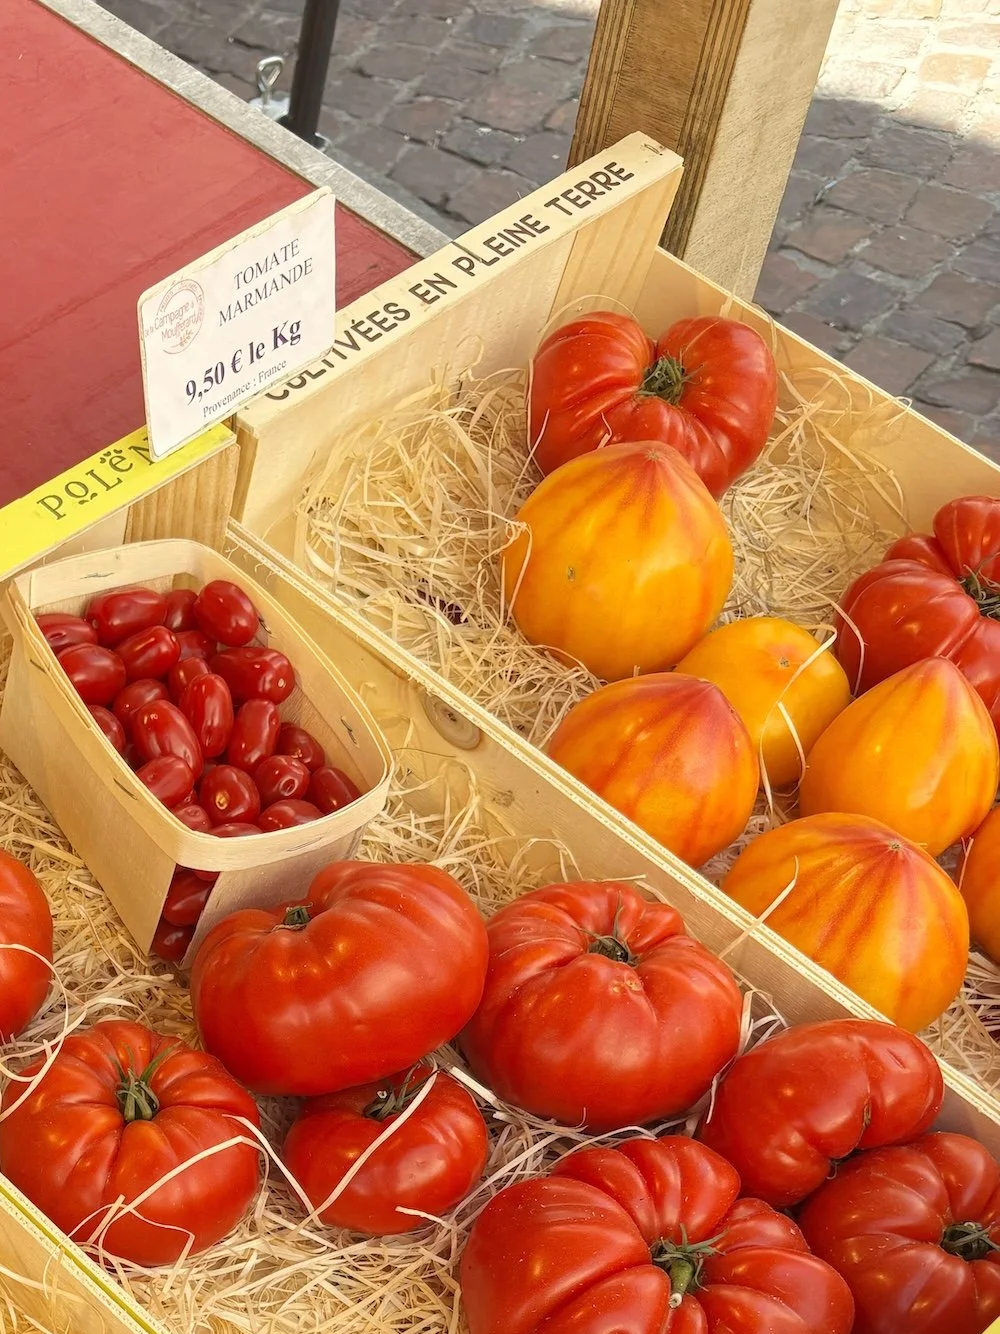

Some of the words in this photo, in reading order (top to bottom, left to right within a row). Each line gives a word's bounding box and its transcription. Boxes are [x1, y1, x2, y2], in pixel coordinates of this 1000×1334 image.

[233, 238, 300, 290] TOMATE
[409, 272, 457, 306] EN
[452, 213, 551, 277] PLEINE
[544, 160, 635, 216] TERRE
[218, 257, 314, 327] MARMANDE
[185, 360, 225, 405] 9,50
[230, 349, 243, 374] €
[249, 340, 266, 364] le
[272, 320, 302, 353] Kg
[203, 381, 251, 418] Provenance
[258, 359, 287, 385] France
